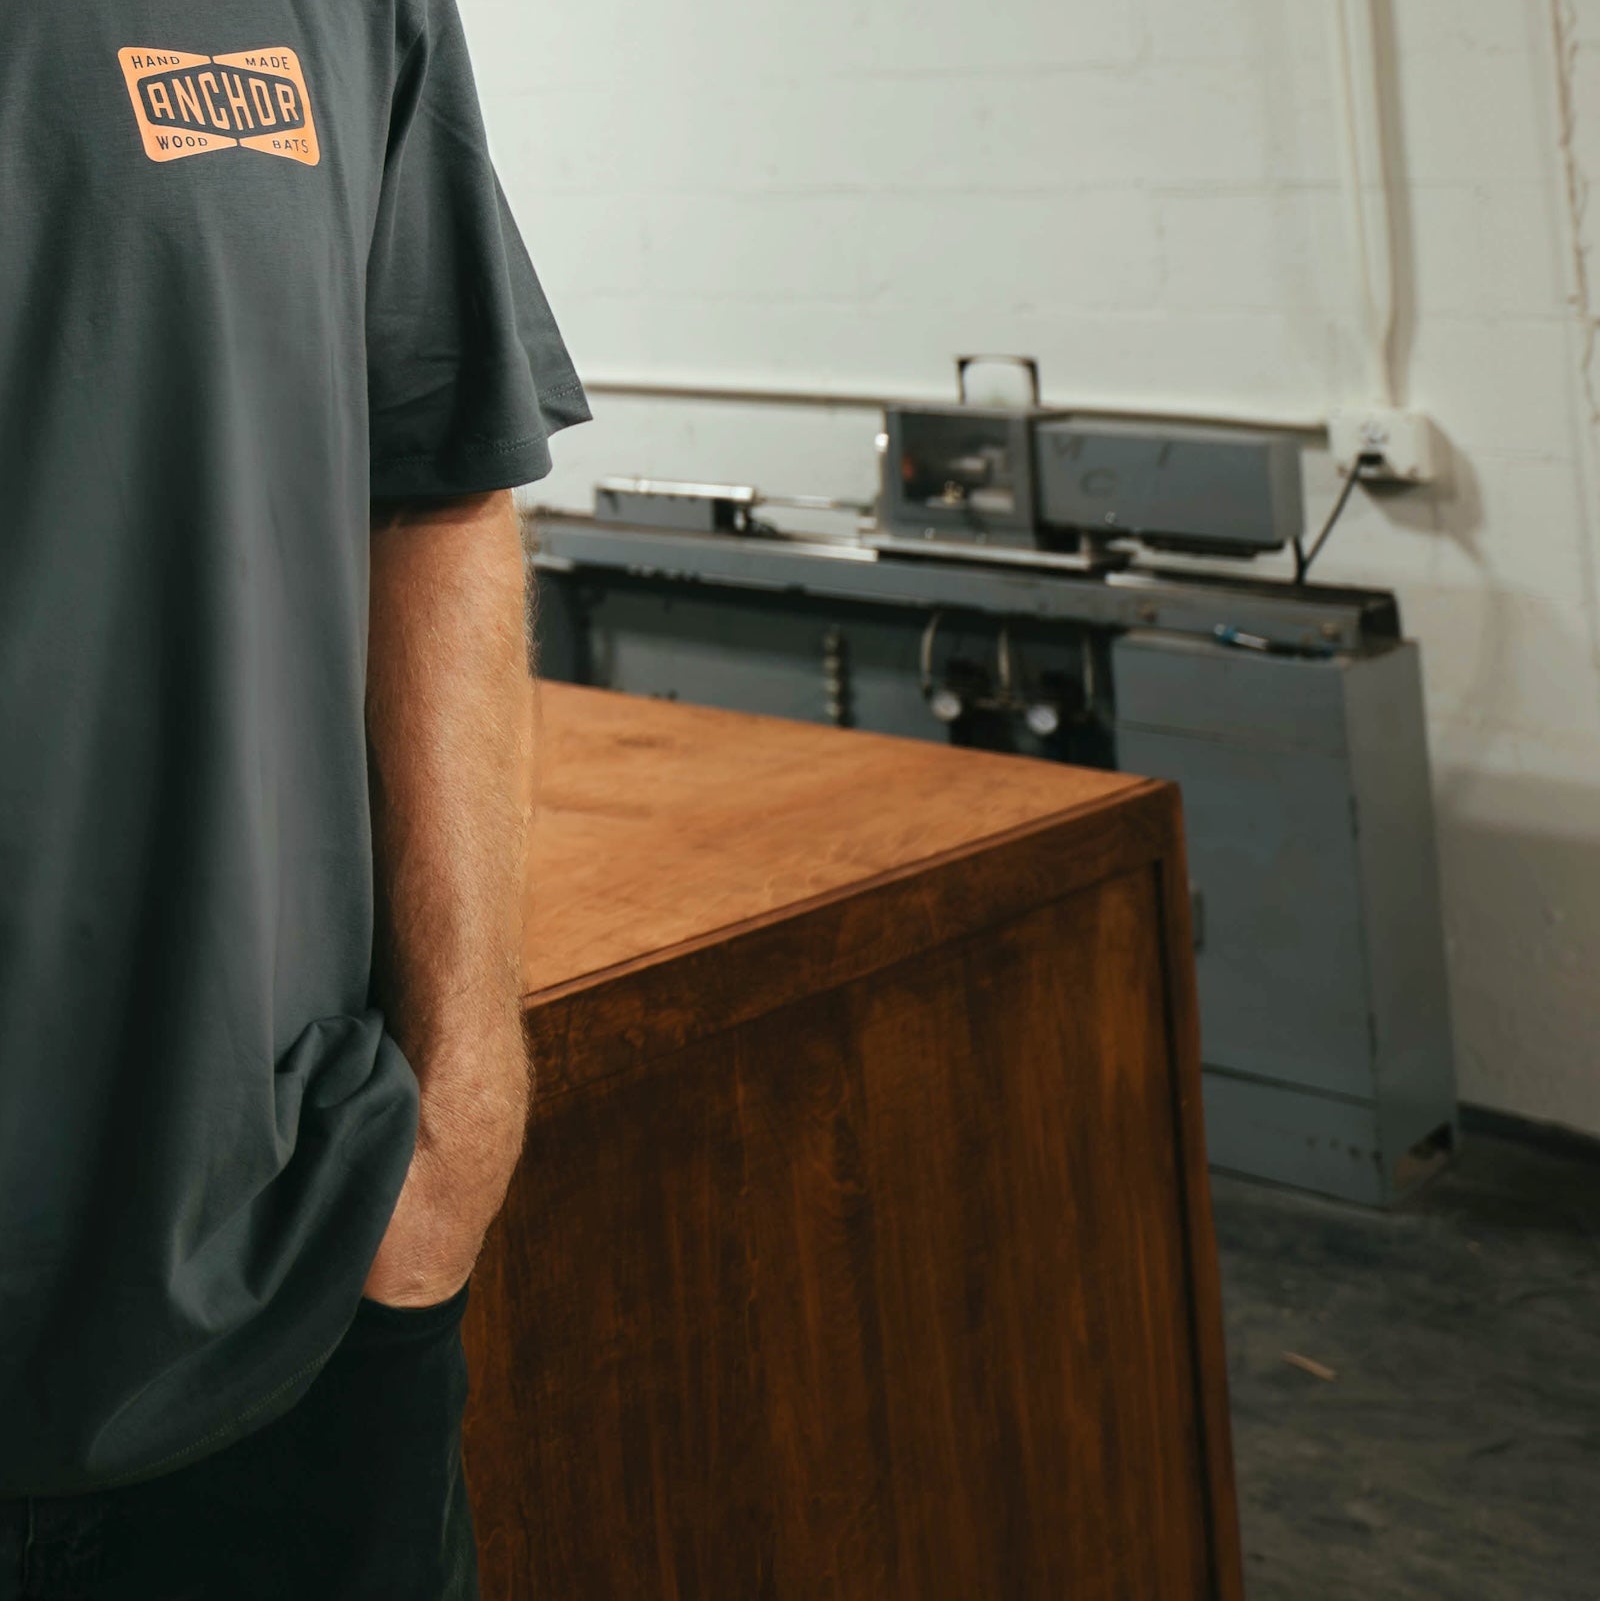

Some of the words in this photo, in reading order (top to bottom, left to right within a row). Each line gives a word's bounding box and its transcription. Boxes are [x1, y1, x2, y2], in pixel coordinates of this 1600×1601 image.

[131, 55, 180, 69] HAND
[245, 56, 290, 70] MADE
[147, 71, 299, 130] ANCHOR
[156, 135, 208, 150] WOOD
[272, 139, 309, 154] BATS
